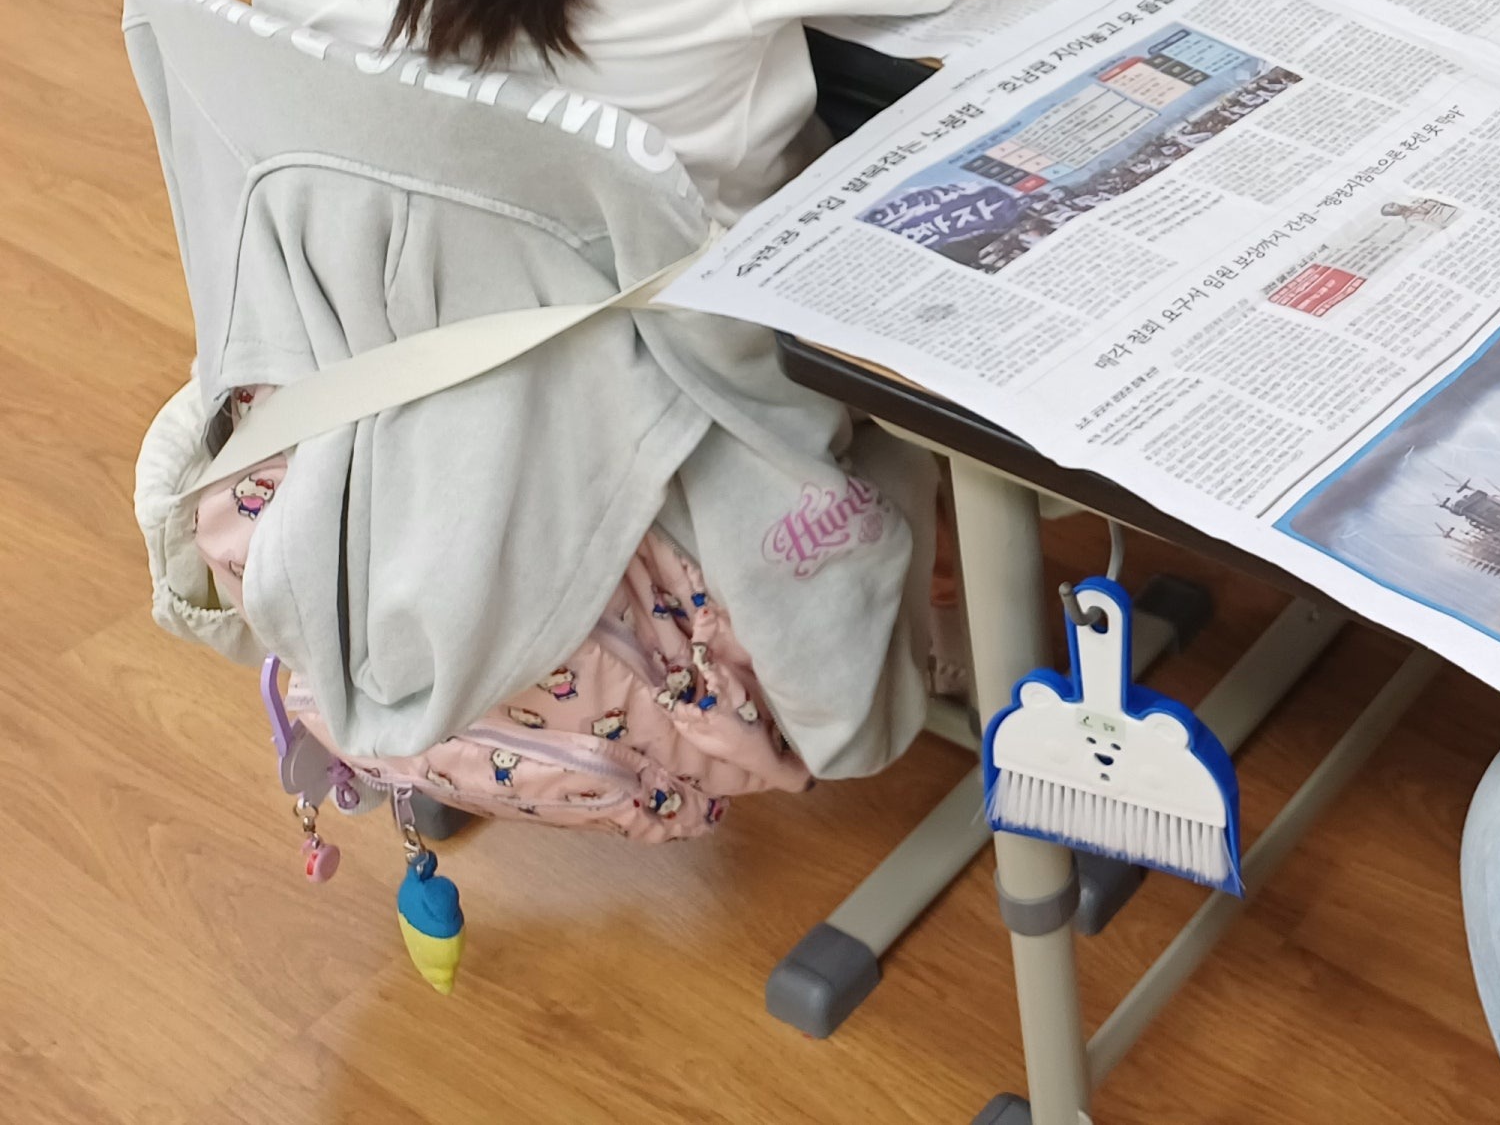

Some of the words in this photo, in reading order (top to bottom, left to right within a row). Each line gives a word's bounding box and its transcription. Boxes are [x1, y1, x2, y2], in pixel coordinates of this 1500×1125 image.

[1160, 285, 1207, 323] 요구서
[1202, 262, 1240, 292] 임원
[1235, 228, 1291, 269] 보상까지
